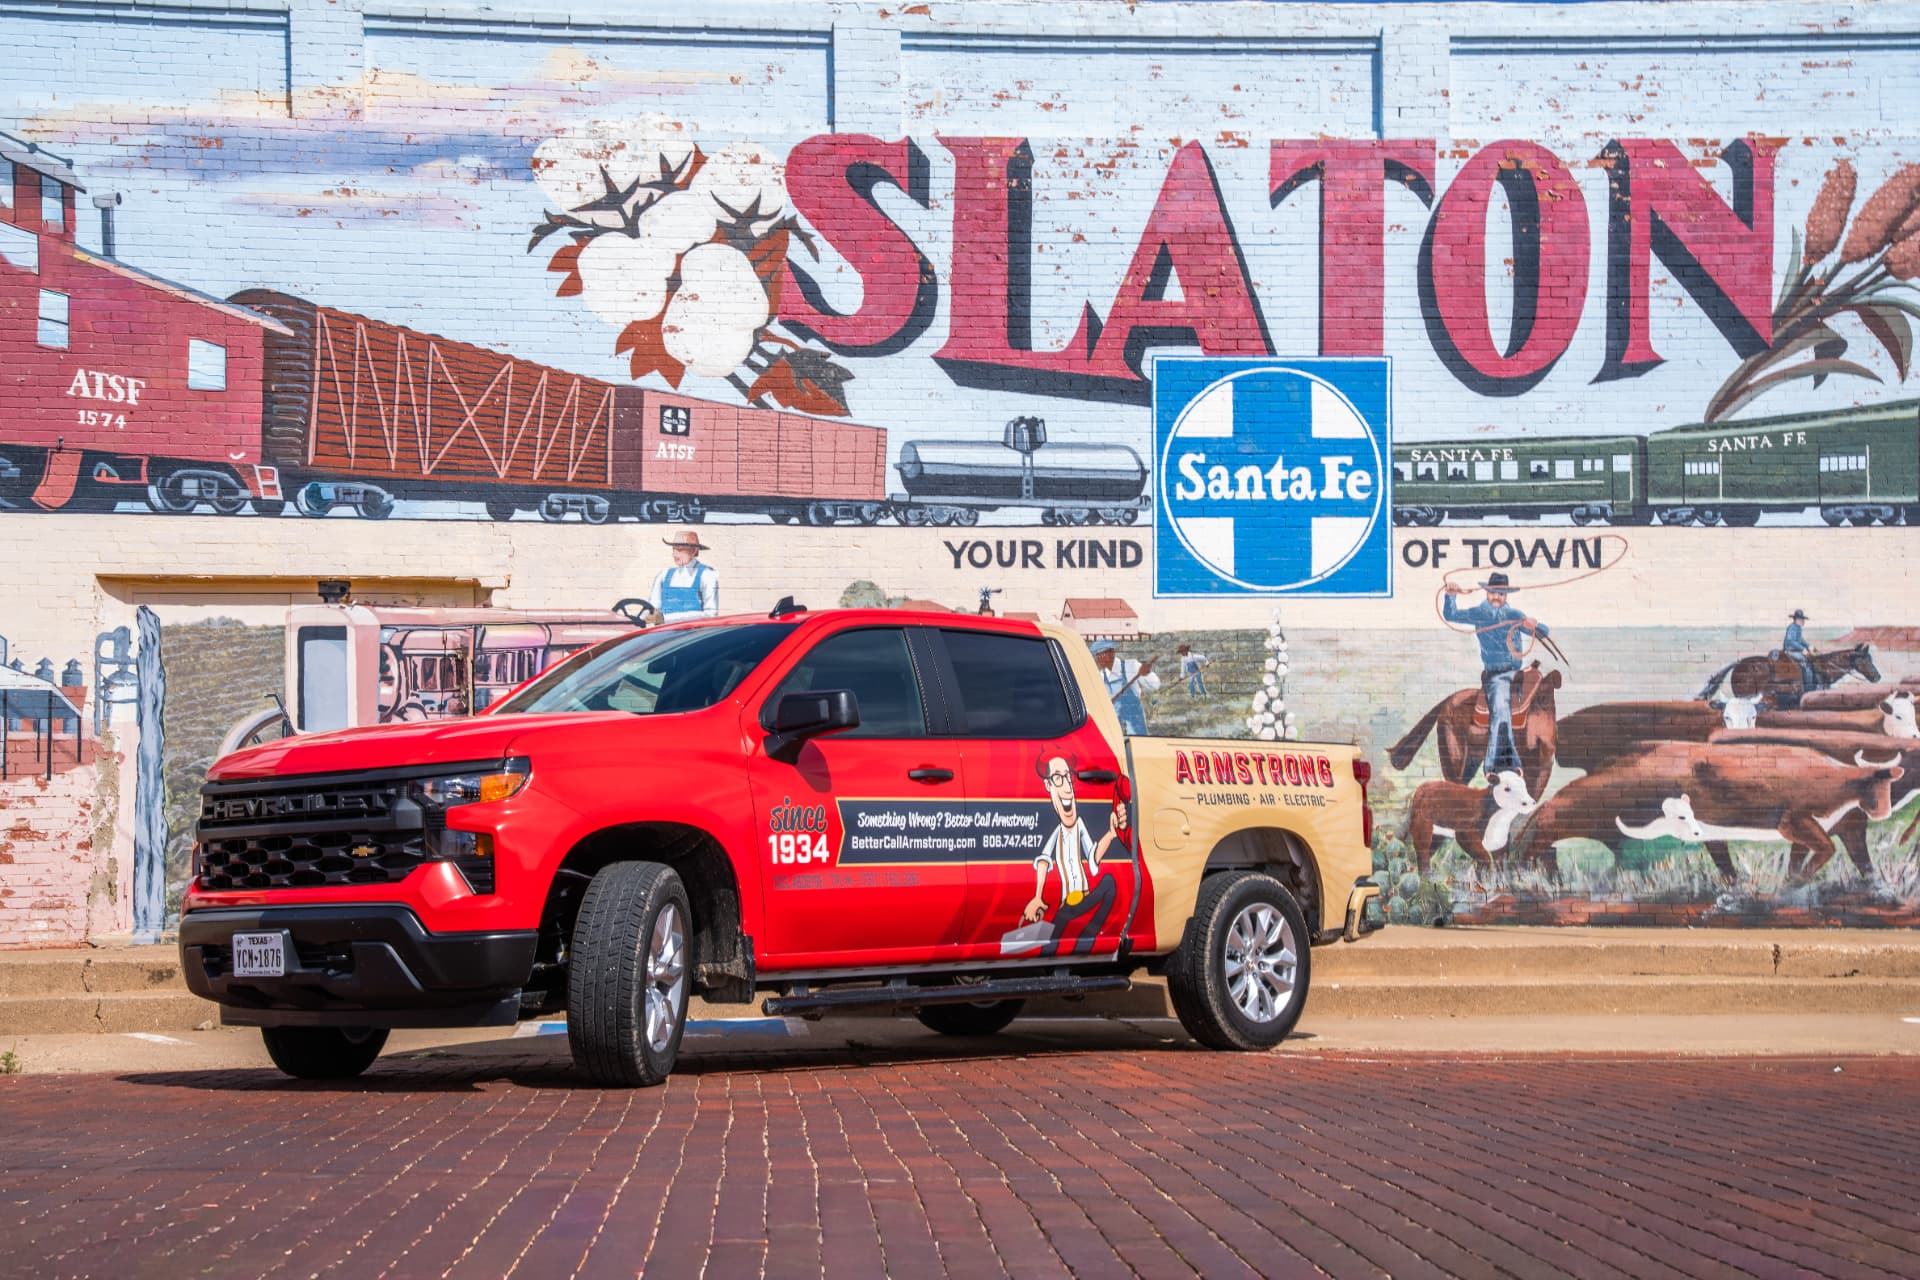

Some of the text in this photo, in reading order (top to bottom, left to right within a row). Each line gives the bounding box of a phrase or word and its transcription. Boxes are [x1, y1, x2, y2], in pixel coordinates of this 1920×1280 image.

[779, 133, 1790, 404] SLATON
[66, 368, 146, 406] ATSF
[77, 409, 127, 429] 1574
[656, 441, 696, 460] ATSF
[1708, 431, 1807, 452] SANTA FE
[1411, 448, 1513, 462] SANTA FE
[1176, 452, 1373, 501] Santa Fe
[943, 540, 1144, 569] YOUR KIND
[1402, 538, 1602, 568] OF TOWN
[1176, 749, 1334, 787] ARMSTRONG
[1197, 793, 1326, 807] PLUMBING AIR ELECTRIC
[770, 796, 828, 833] since
[857, 811, 1039, 831] Something Wrong? Better Call Armstrong!
[768, 833, 830, 864] 1934
[851, 834, 1043, 851] BetterCallArmstrong.com 806.747.4217
[248, 937, 268, 945] TEXAS
